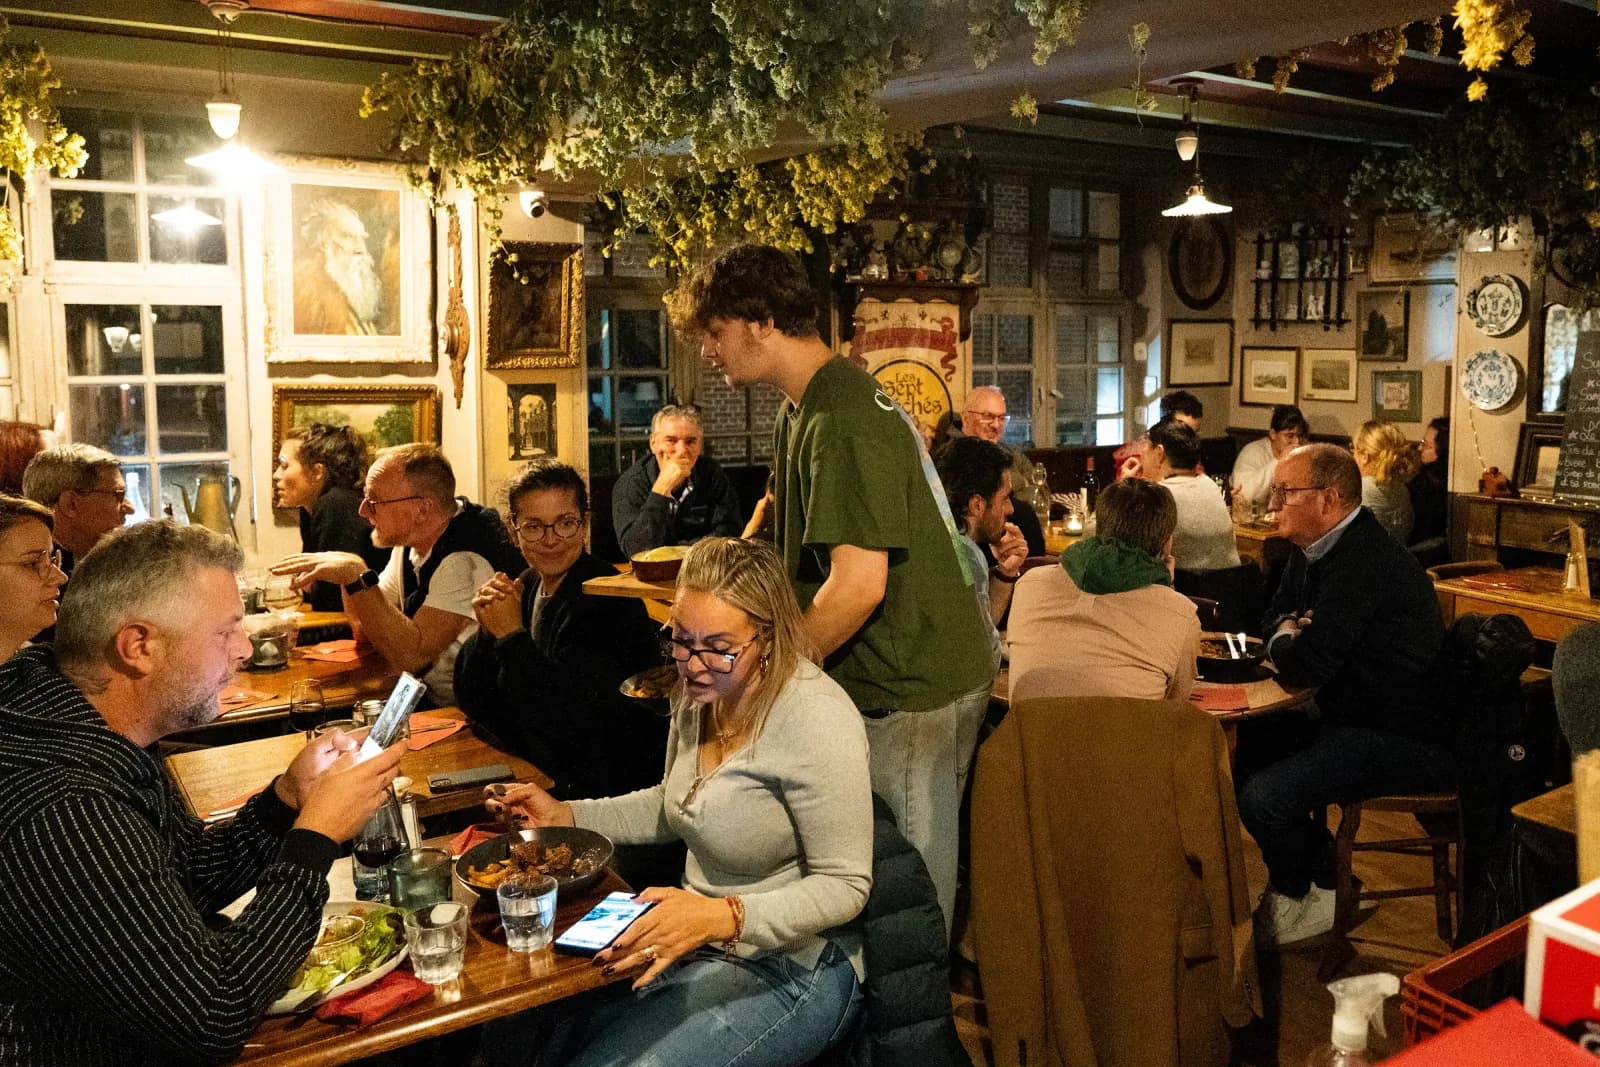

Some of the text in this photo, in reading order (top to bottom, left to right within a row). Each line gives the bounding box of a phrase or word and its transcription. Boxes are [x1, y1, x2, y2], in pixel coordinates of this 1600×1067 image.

[896, 373, 916, 383] Les
[883, 377, 922, 400] Sept
[896, 394, 942, 414] chés
